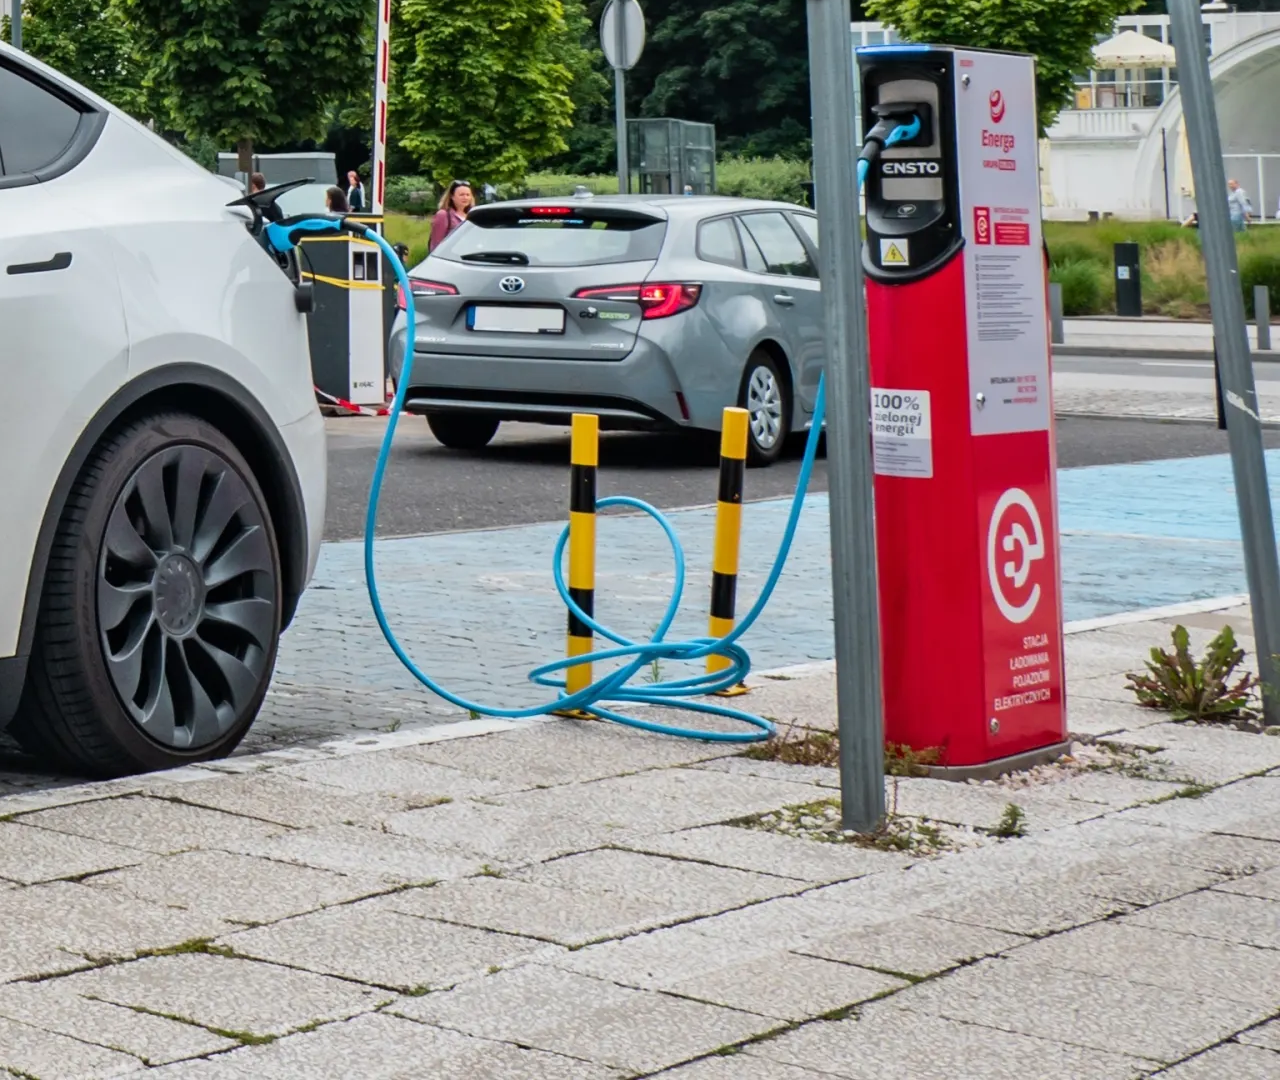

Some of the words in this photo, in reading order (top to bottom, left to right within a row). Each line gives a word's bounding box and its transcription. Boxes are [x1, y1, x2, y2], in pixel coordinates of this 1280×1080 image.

[981, 129, 1015, 153] Energa
[882, 161, 940, 175] ENSTO
[874, 394, 920, 411] 100%
[875, 412, 922, 427] zielonej
[876, 423, 915, 437] energii
